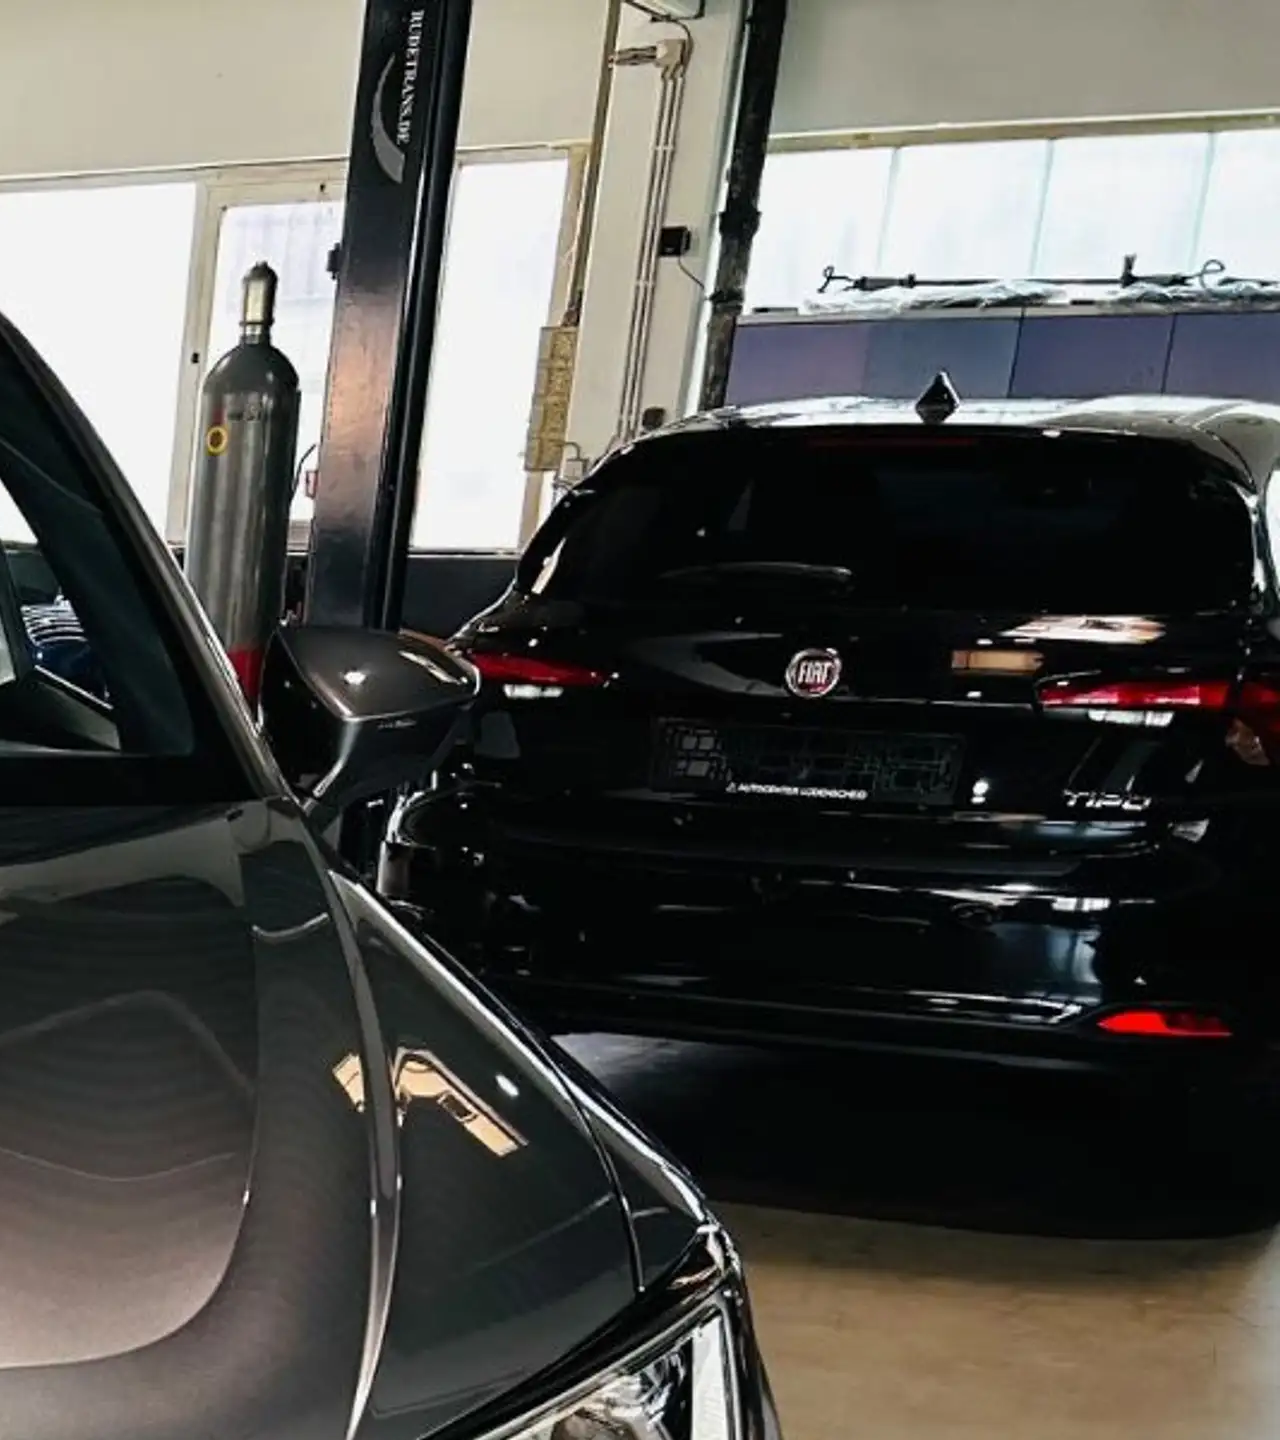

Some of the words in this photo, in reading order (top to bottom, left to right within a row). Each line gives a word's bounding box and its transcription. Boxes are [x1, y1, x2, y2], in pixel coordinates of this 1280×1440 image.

[396, 10, 425, 145] RUDETRANS.DE
[797, 660, 834, 685] FIAT
[1063, 789, 1152, 811] TIPO
